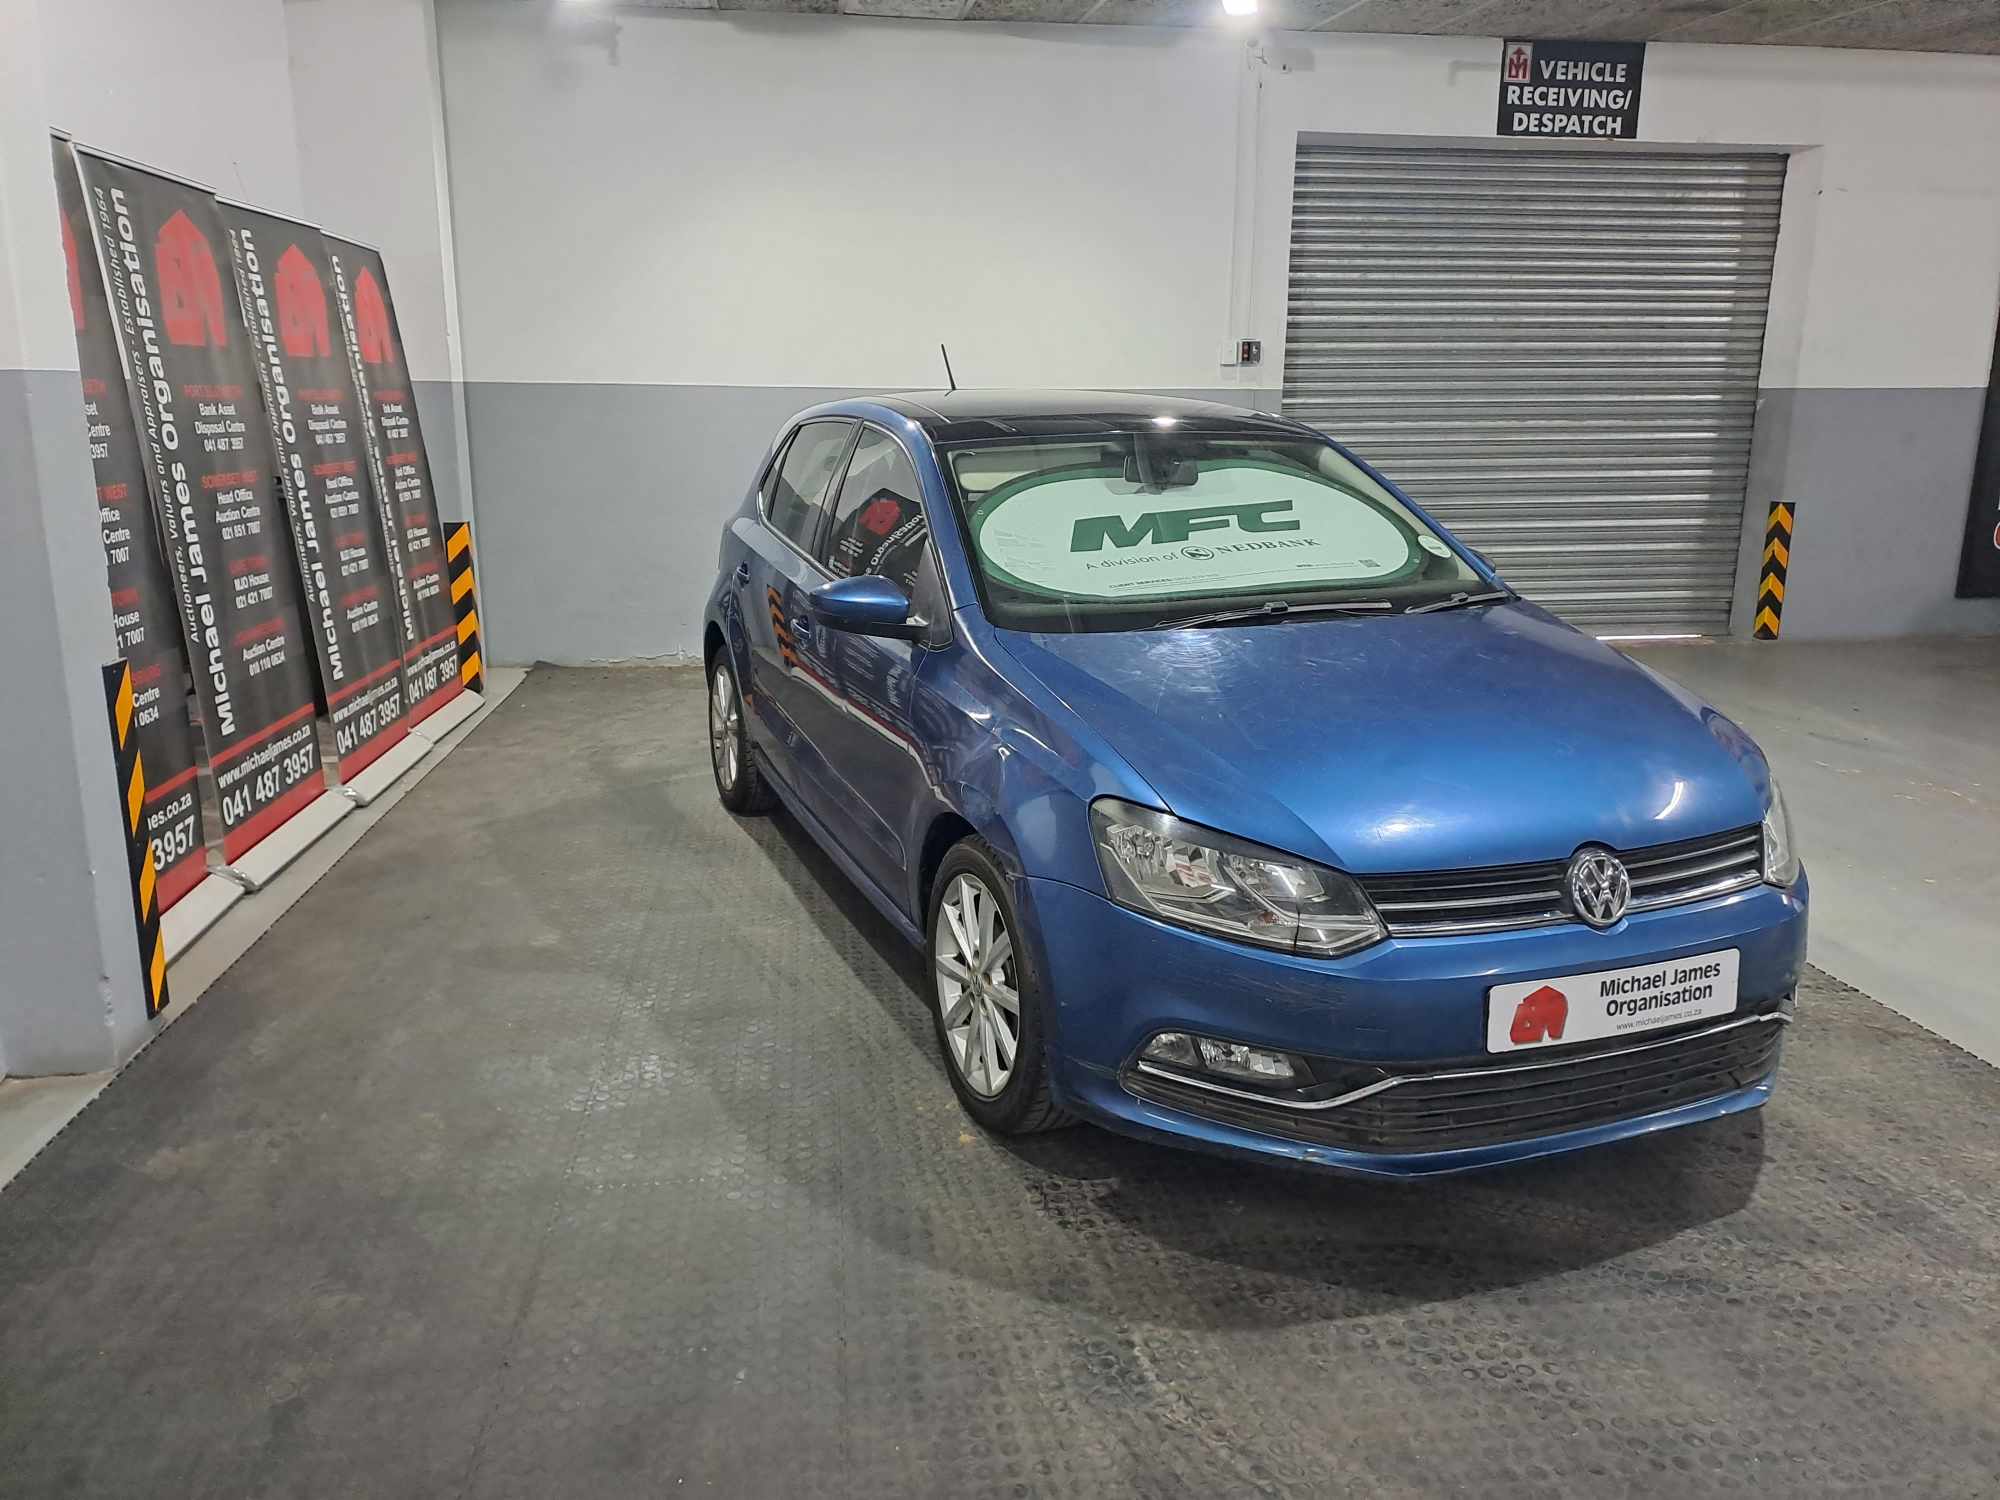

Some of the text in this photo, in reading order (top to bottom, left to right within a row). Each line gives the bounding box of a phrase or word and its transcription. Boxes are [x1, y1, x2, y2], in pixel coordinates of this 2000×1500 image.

[1540, 60, 1627, 83] VEHICLE
[1506, 85, 1633, 110] RECEIVING/
[1513, 112, 1623, 135] DESPATCH
[94, 186, 112, 230] 1964
[104, 234, 135, 334] Established
[241, 229, 296, 444] Organisation
[132, 351, 158, 438] Appraisers
[111, 188, 236, 736] Michael James Organisation
[149, 441, 165, 475] and
[161, 480, 178, 540] Valuers
[290, 453, 319, 553] James
[1070, 499, 1300, 553] MFC
[102, 527, 131, 545] Centre
[110, 547, 129, 566] 7007
[1100, 555, 1161, 568] division
[1163, 552, 1179, 561] of
[1215, 538, 1321, 555] NEDBANK
[176, 546, 199, 643] Auctioneers,
[126, 627, 145, 647] 7007
[311, 562, 344, 681] Michael
[132, 687, 160, 708] Centre
[408, 654, 458, 705] 041 487 3957
[139, 706, 159, 725] 0634
[336, 693, 401, 754] 041 487 3957
[218, 724, 311, 789] www.michaeljames.co.za
[222, 743, 314, 826] 041 487 3957
[151, 815, 195, 871] 3957
[1600, 962, 1721, 998] Michael James
[1606, 982, 1713, 1017] Organisation
[1616, 1008, 1702, 1031] www.michaeljames.co.za
